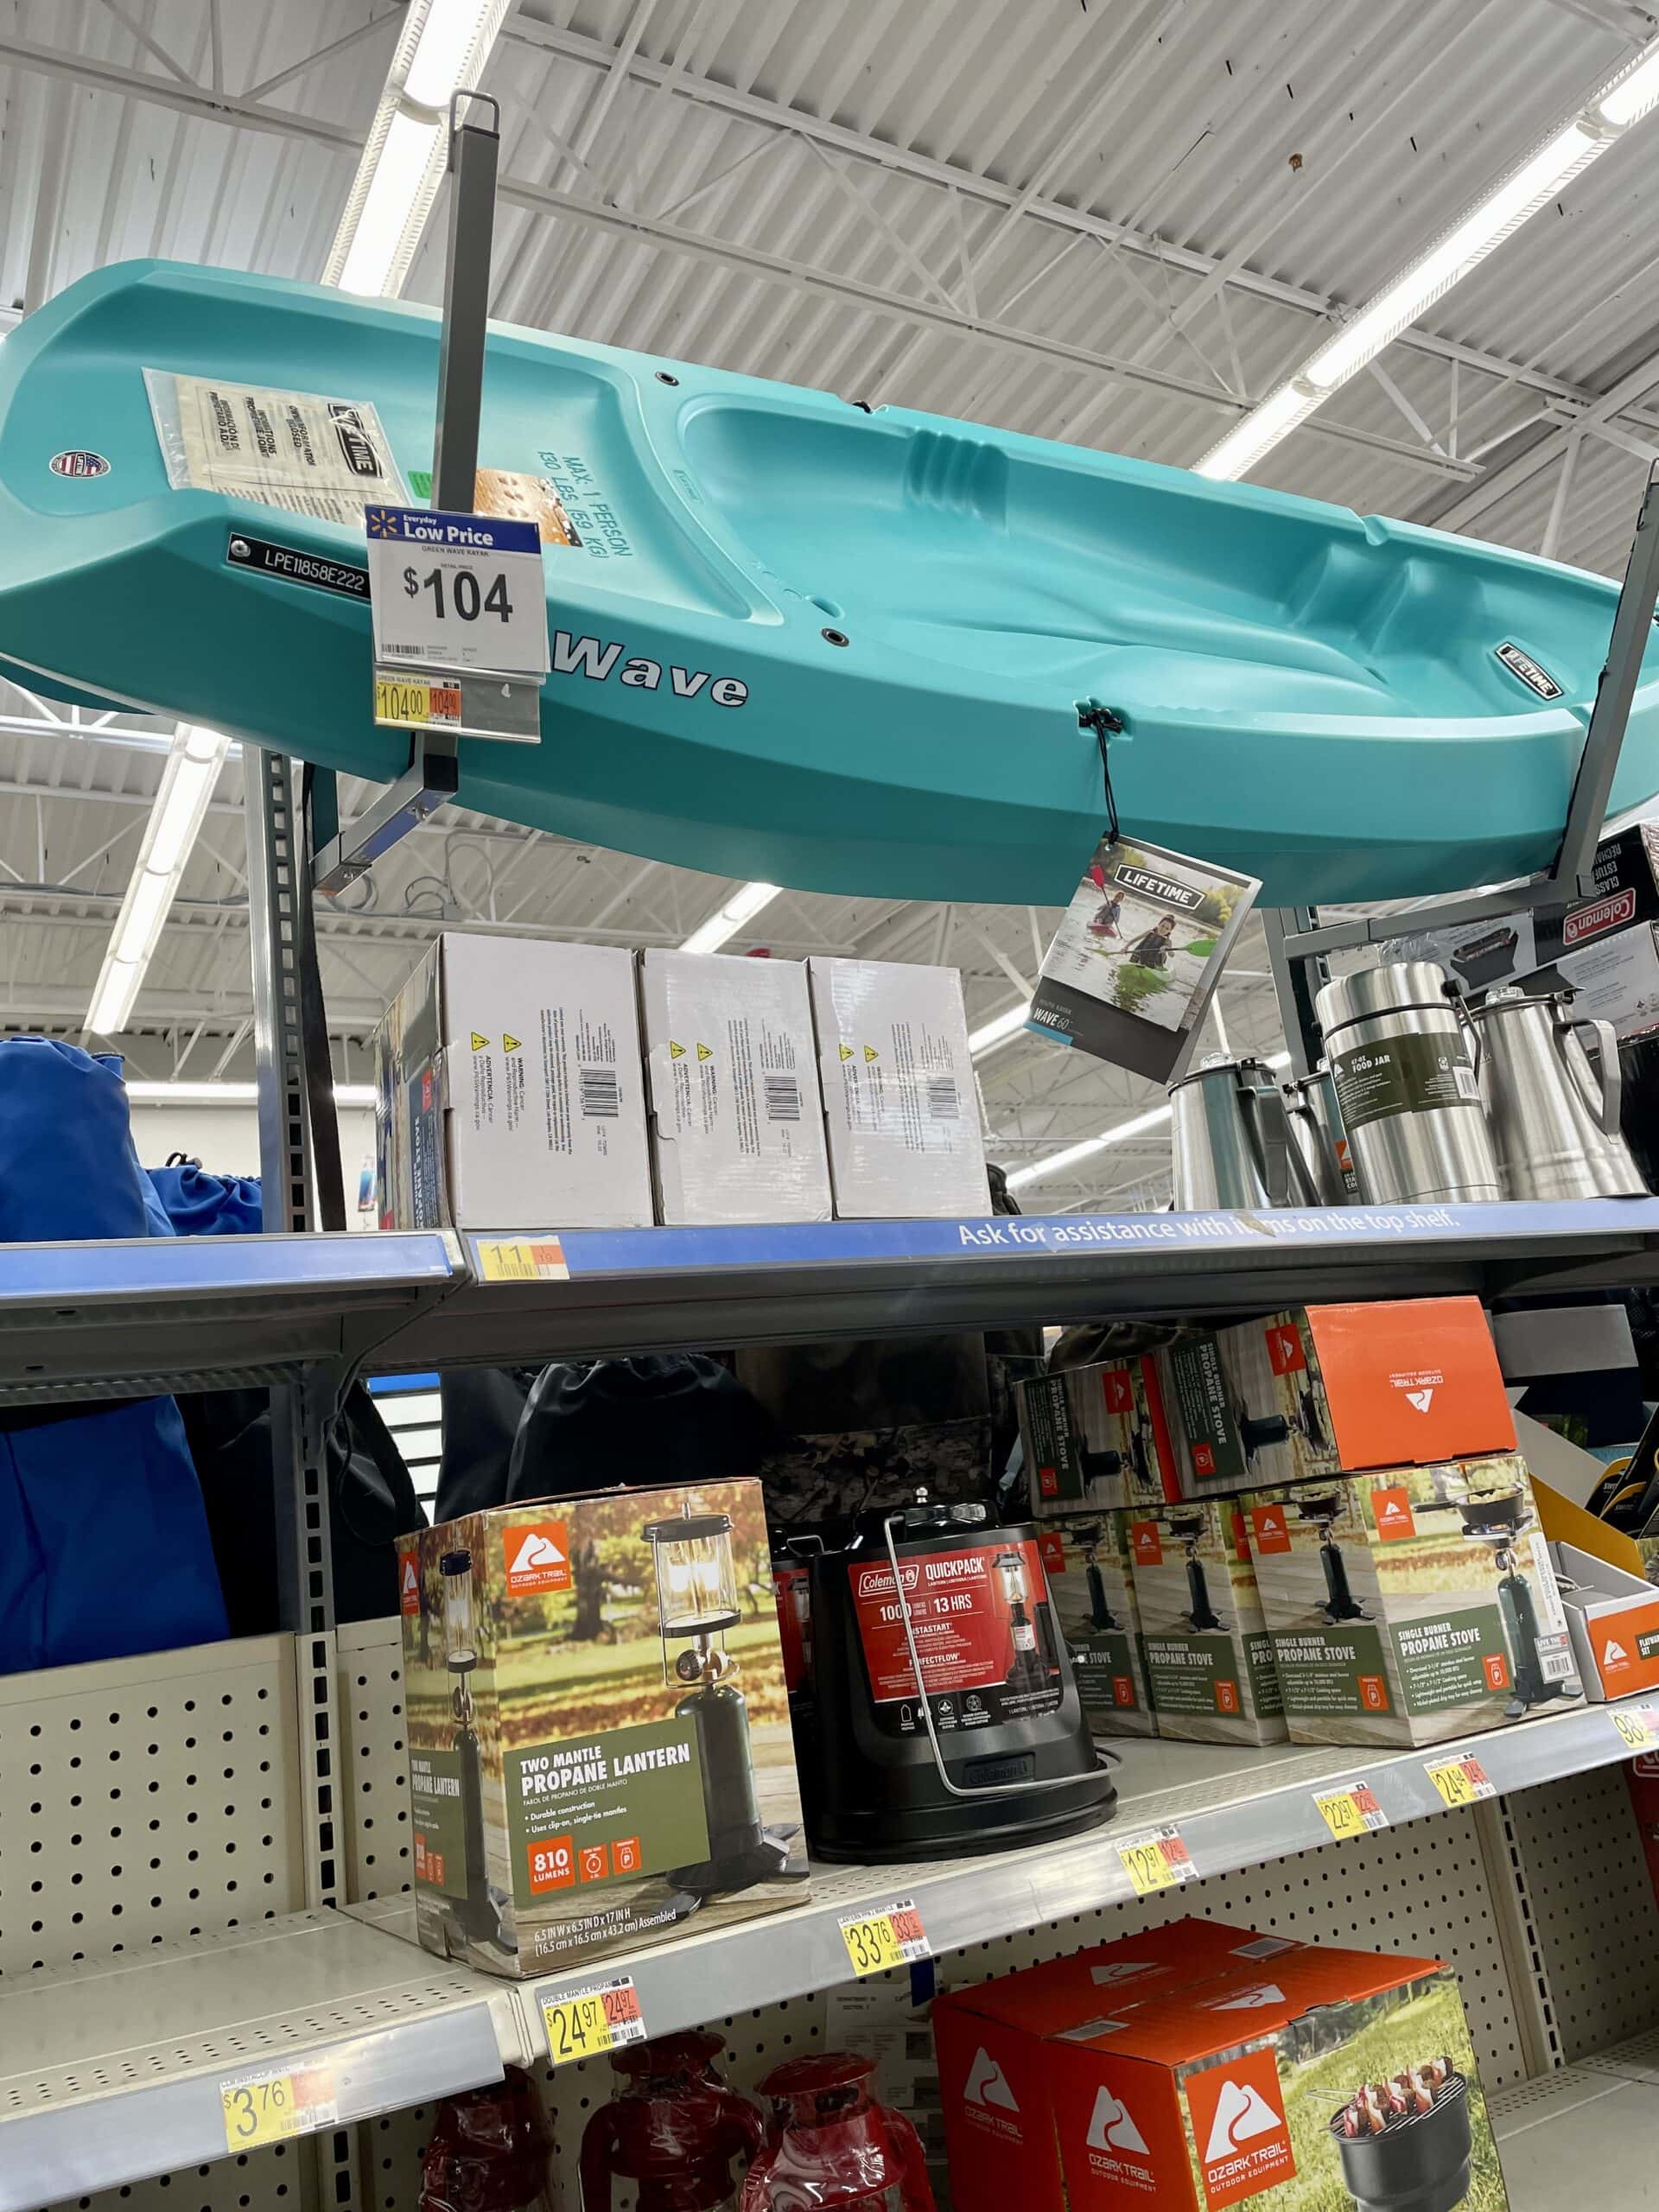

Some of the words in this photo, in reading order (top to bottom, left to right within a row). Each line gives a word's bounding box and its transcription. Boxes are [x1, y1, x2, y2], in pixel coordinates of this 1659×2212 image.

[537, 450, 561, 471] 130
[550, 476, 579, 503] LBS
[403, 514, 438, 525] Everyday
[591, 501, 633, 557] PERSON
[404, 524, 444, 541] Low
[447, 526, 494, 546] Price
[264, 550, 365, 592] LPE11858E222
[552, 630, 748, 707] Wave
[1123, 869, 1192, 905] LIFETIME
[1578, 899, 1630, 931] Coleman
[1033, 1007, 1058, 1026] WAVE
[1352, 1060, 1372, 1073] FOOD
[1375, 1054, 1391, 1065] JAR
[959, 1224, 1010, 1245] Ask
[1008, 1222, 1047, 1243] for
[1052, 1220, 1176, 1243] assistance
[1176, 1214, 1231, 1237] with
[1298, 1217, 1328, 1232] on
[1327, 1211, 1365, 1231] the
[1363, 1214, 1405, 1233] top
[1404, 1208, 1461, 1229] shelf.
[1199, 1344, 1217, 1402] PROPANE
[1211, 1405, 1227, 1445] STOVE
[1057, 1434, 1070, 1470] STOVE
[925, 1558, 983, 1580] QUICKPACK
[934, 1598, 949, 1613] 13
[950, 1594, 972, 1611] HRS
[1274, 1637, 1296, 1648] SINGLE
[1398, 1628, 1422, 1642] SINGLE
[1423, 1623, 1452, 1637] BURNER
[1400, 1635, 1449, 1656] PROPANE
[1450, 1628, 1481, 1646] STOVE
[1249, 1640, 1271, 1650] SINGL
[1277, 1647, 1322, 1662] PROPANE
[1325, 1646, 1356, 1660] STOVE
[909, 1653, 960, 1666] PFECTFLOW
[1089, 1651, 1112, 1664] STOVE
[1149, 1652, 1186, 1665] PROPANE
[1187, 1653, 1214, 1666] STOVE
[520, 1757, 550, 1774] TWO
[553, 1745, 602, 1768] MANTLE
[521, 1761, 607, 1796] PROPANE
[613, 1743, 690, 1777] LANTERN
[434, 1777, 460, 1797] LANTERN
[531, 1808, 556, 1821] Durable
[557, 1802, 595, 1815] construction
[531, 1823, 547, 1834] Uses
[534, 1848, 569, 1872] 810
[534, 1867, 570, 1883] LUMENS
[534, 1929, 547, 1942] 6.5
[548, 1927, 556, 1940] IN
[571, 1922, 584, 1934] 6.5
[584, 1918, 594, 1930] IN
[606, 1913, 615, 1924] 17
[615, 1910, 624, 1923] IN
[625, 1908, 631, 1919] H
[574, 1933, 589, 1946] 16.5
[607, 1923, 624, 1937] 43.2
[639, 1909, 677, 1929] Assembled
[1089, 2153, 1122, 2174] OZARK
[1124, 2164, 1155, 2183] TRAIL
[1208, 2155, 1251, 2183] OZARK
[1251, 2142, 1287, 2164] TRAIL
[1211, 2175, 1246, 2193] OUTDOOR
[1248, 2156, 1288, 2177] EQUIPMENT
